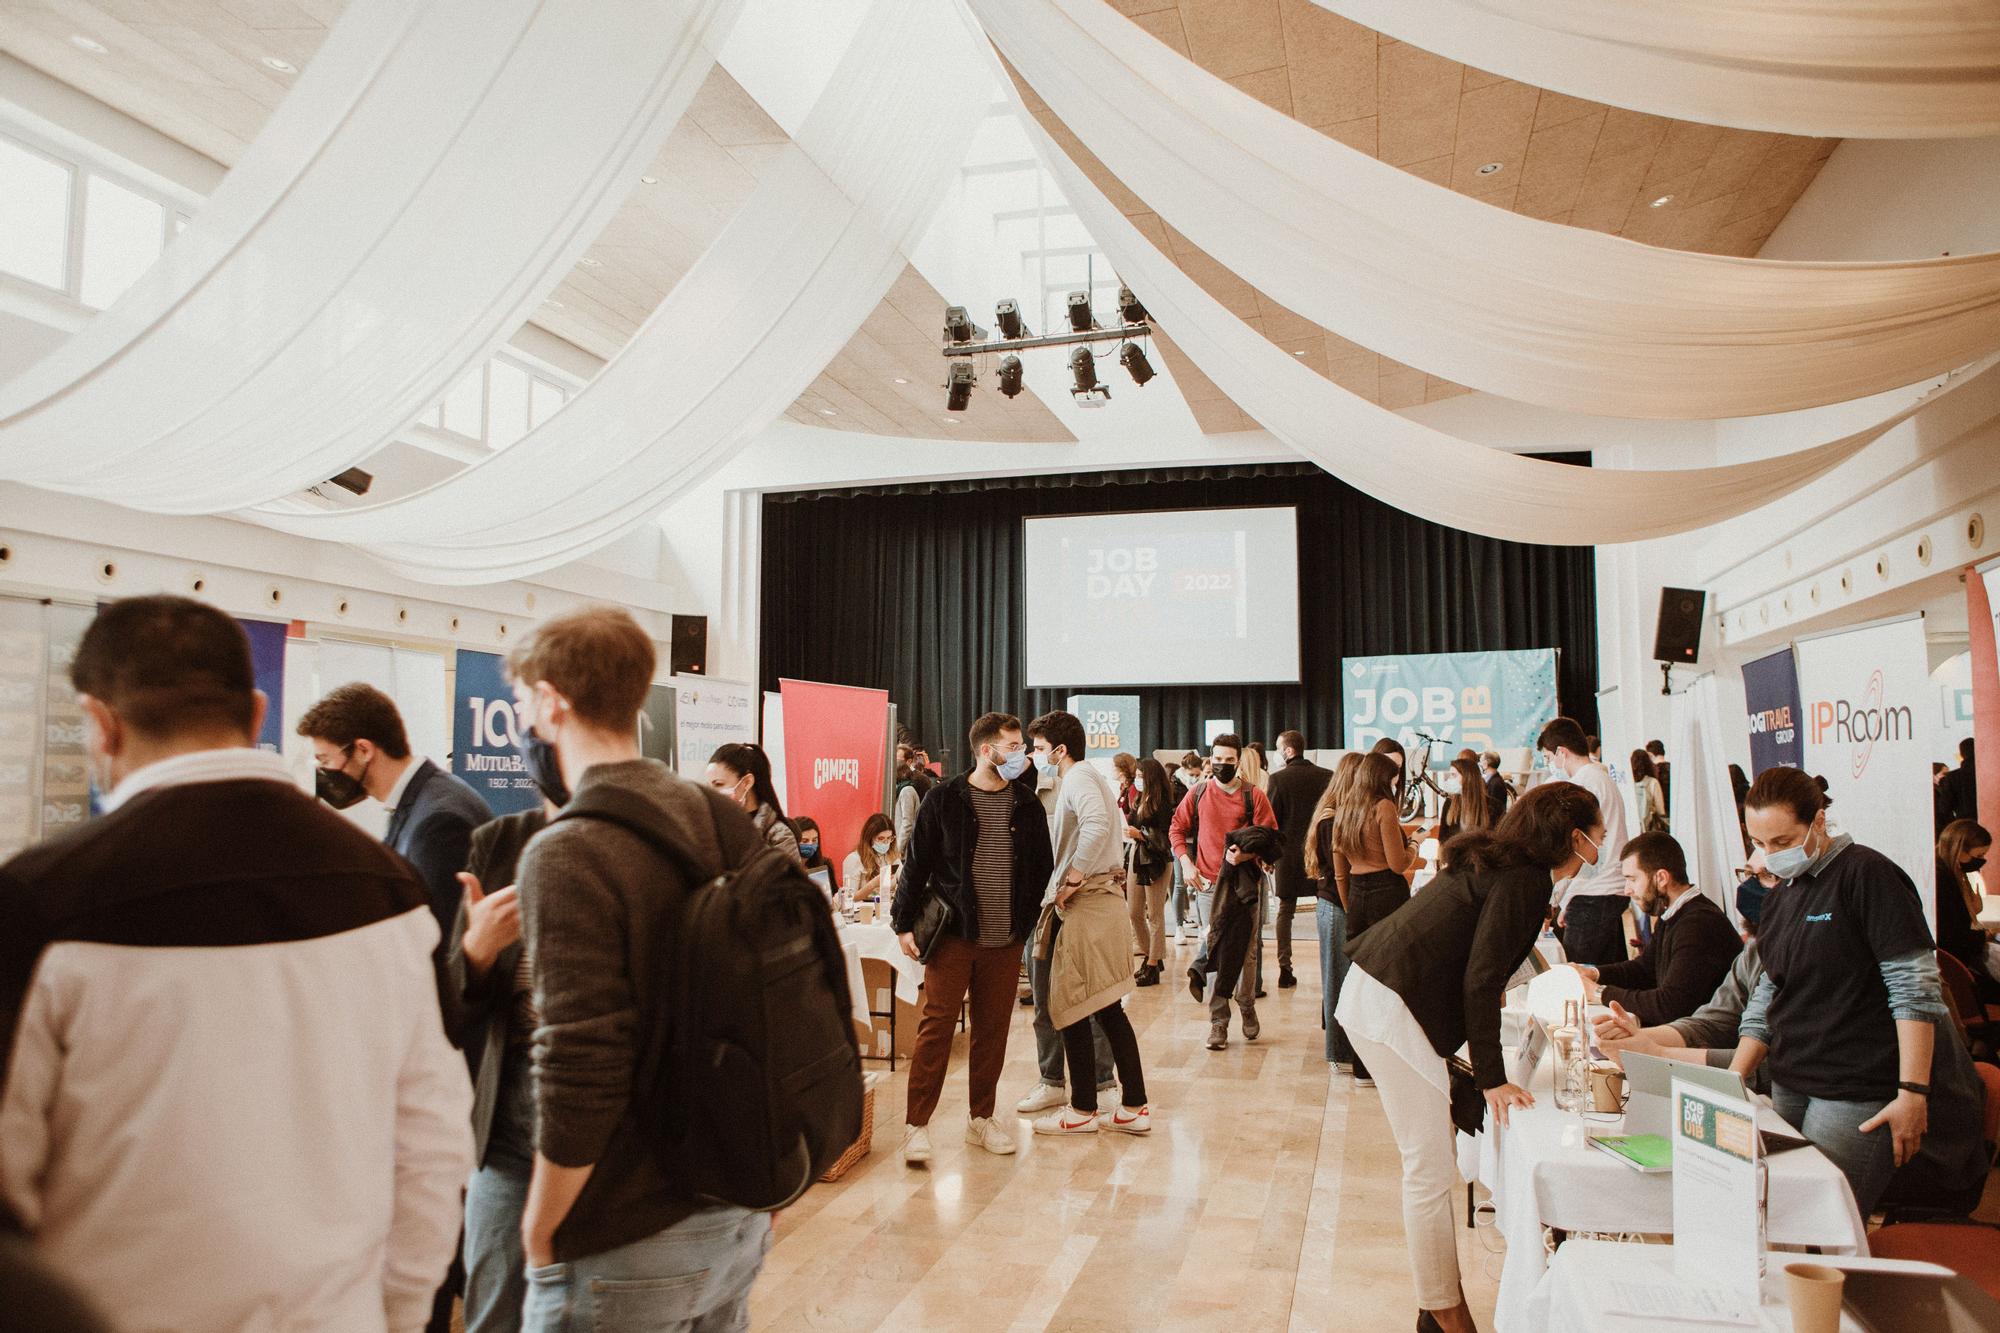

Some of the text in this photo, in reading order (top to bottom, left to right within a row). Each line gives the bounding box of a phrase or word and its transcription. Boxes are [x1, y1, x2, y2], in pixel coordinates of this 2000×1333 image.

[1087, 547, 1158, 574] JOB
[1087, 573, 1156, 599] DAY
[1185, 574, 1232, 590] 2022
[1352, 686, 1456, 725] JOB
[1087, 711, 1120, 723] JOB
[1087, 723, 1120, 735] DAY
[1776, 729, 1795, 744] GROUP
[1087, 735, 1120, 749] UIB
[814, 758, 858, 790] CAMPER
[488, 778, 508, 788] 1922
[1684, 1098, 1704, 1115] JOB
[1684, 1106, 1704, 1126] DAY
[1684, 1120, 1704, 1140] UIB
